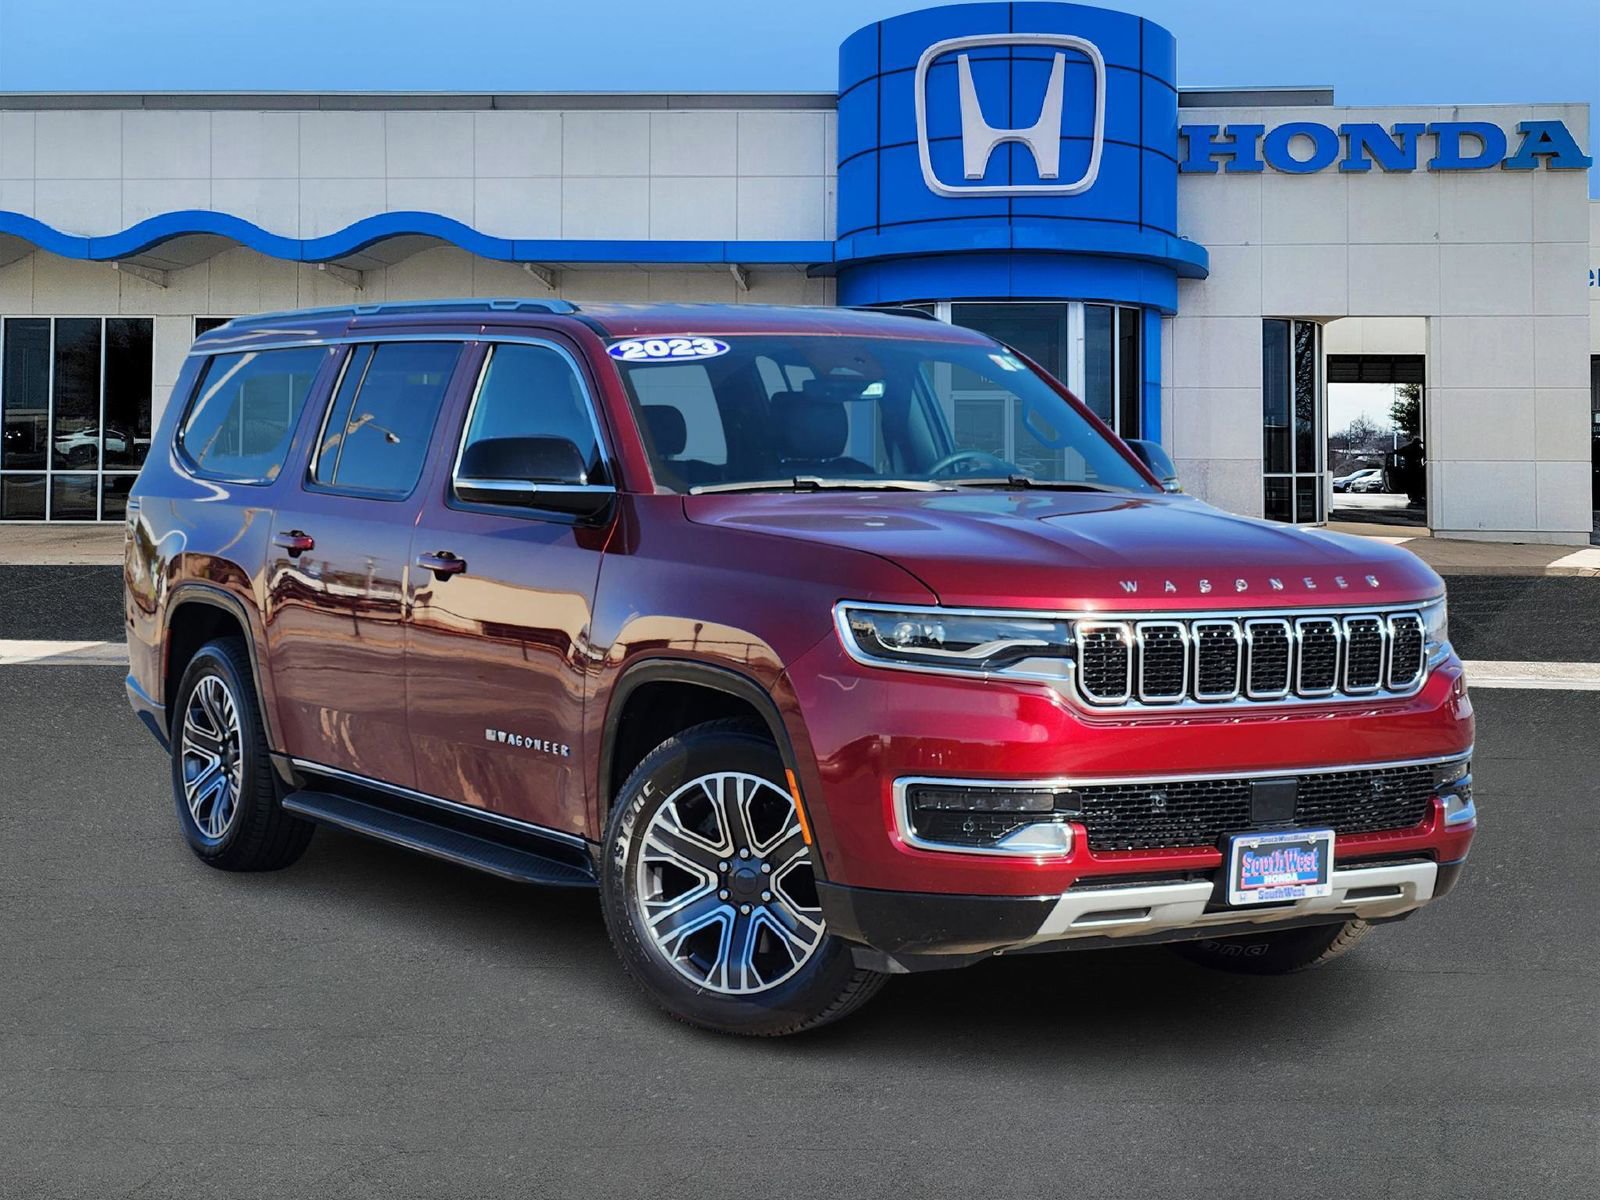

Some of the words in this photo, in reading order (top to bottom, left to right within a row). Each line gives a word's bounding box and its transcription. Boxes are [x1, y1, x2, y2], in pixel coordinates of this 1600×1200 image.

[1179, 120, 1593, 174] HONDA
[618, 338, 718, 360] 2023
[497, 730, 569, 757] WAGONEER
[1263, 872, 1299, 885] HONDA
